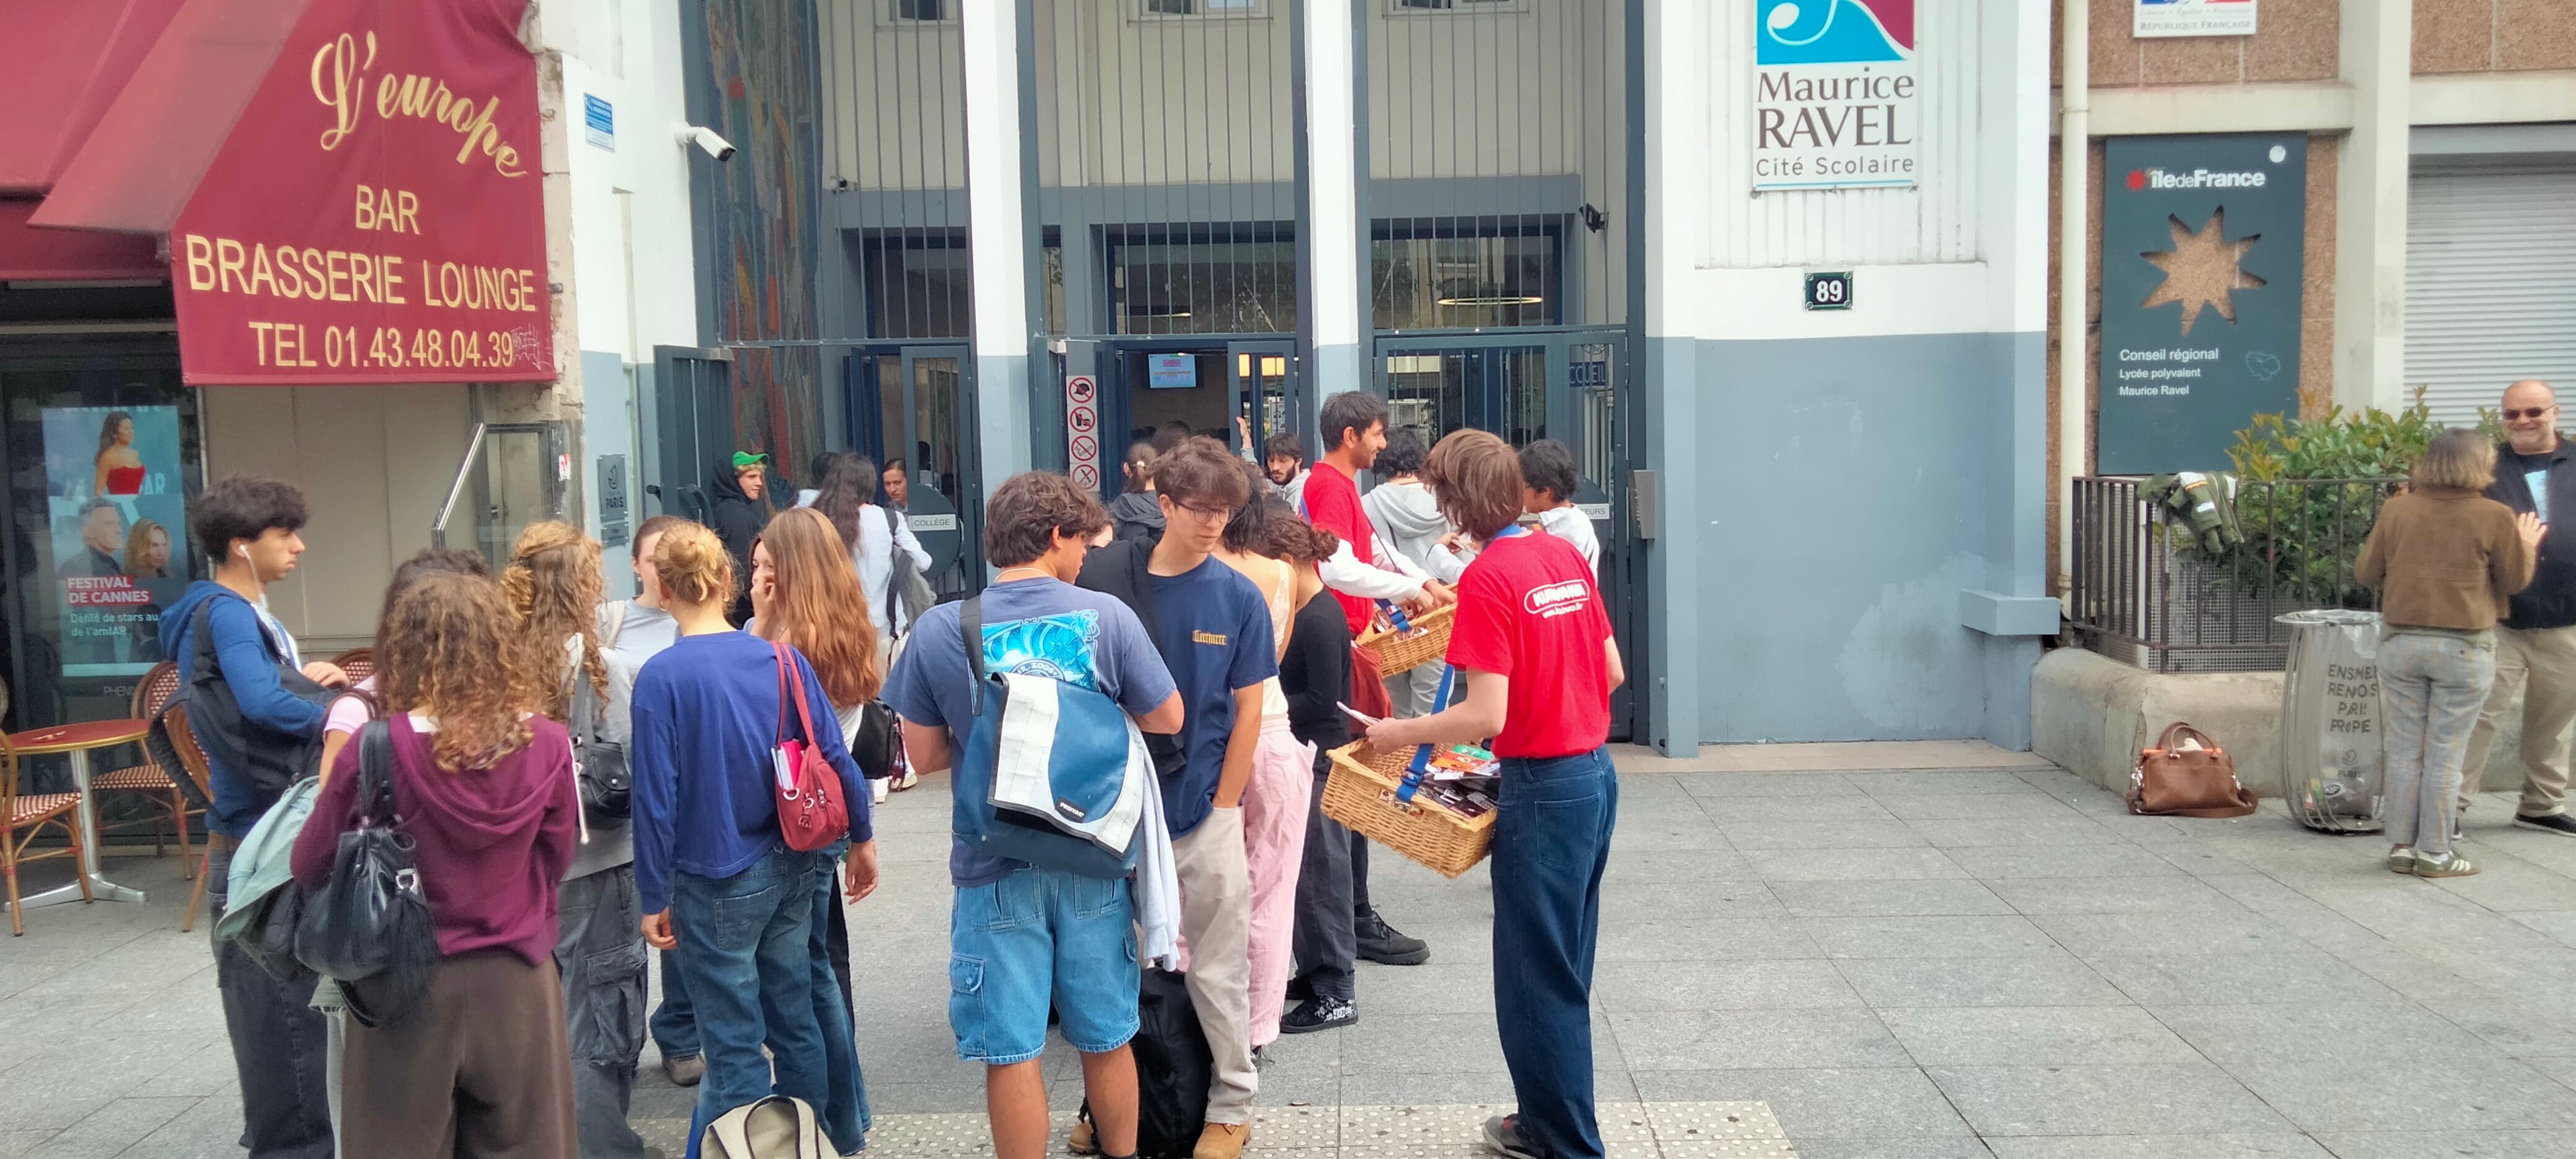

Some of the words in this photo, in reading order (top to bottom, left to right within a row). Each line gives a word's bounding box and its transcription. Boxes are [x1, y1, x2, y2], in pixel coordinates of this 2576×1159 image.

[1757, 66, 1915, 103] Maurice
[311, 30, 529, 178] L'europe
[1757, 104, 1913, 150] RAVEL
[1756, 156, 1804, 176] Cité
[1815, 154, 1914, 175] Scolaire
[356, 184, 421, 235] BAR
[186, 234, 407, 305] BRASSERIE
[423, 260, 537, 313] LOUNGE
[1816, 280, 1843, 302] 89
[248, 321, 317, 368] TEL
[325, 325, 515, 368] 01.43.48.04.39
[2120, 349, 2166, 361] Conseil
[2169, 347, 2219, 362] régional
[2119, 368, 2149, 380] Lycée
[2151, 368, 2201, 380] polyvalent
[2119, 386, 2159, 396] Maurice
[2161, 385, 2190, 395] Ravel
[606, 496, 624, 508] PARIS
[68, 575, 132, 590] FESTIVAL
[68, 592, 88, 604] DE
[91, 590, 150, 603] CANNES
[103, 612, 115, 622] de
[118, 612, 144, 622] stars
[146, 613, 159, 622] au
[71, 625, 85, 636] de
